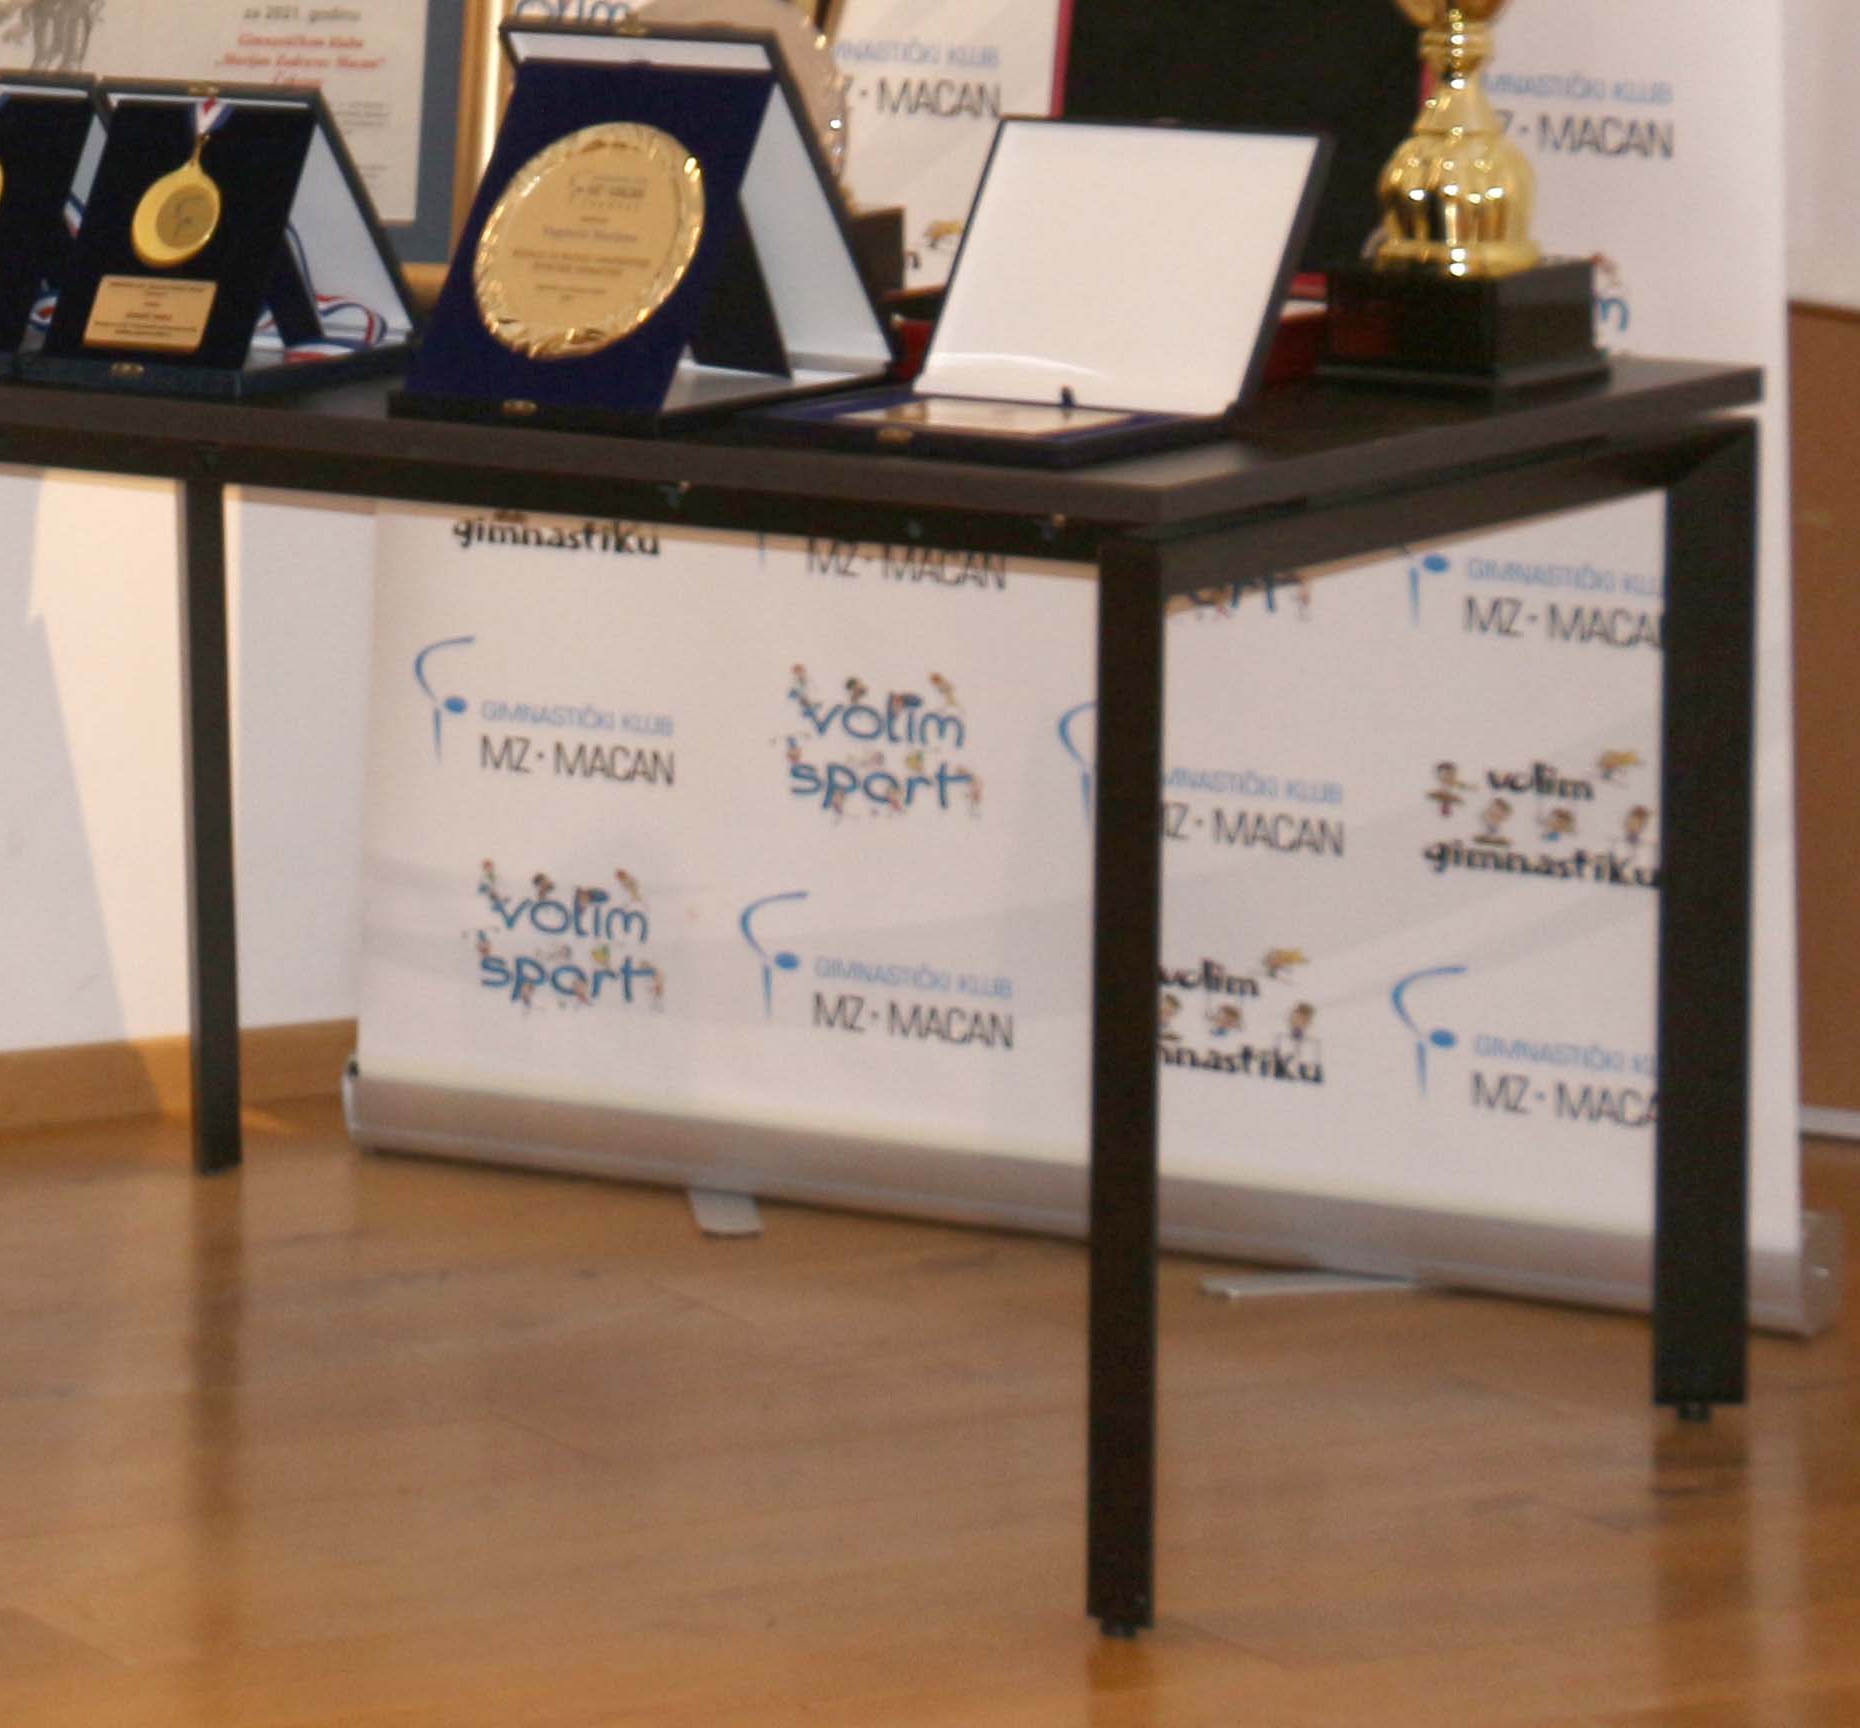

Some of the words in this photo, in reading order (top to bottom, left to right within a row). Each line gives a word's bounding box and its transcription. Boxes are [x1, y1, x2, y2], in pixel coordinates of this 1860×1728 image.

[877, 76, 1001, 119] MACAN
[1538, 113, 1675, 160] MACAN
[453, 516, 661, 556] gimnastiku
[1463, 594, 1523, 637] MZ
[1547, 602, 1662, 652] MACA
[621, 711, 674, 737] KLUB
[795, 694, 965, 748] volim
[480, 735, 531, 773] MZ
[554, 741, 675, 787] MACAN
[1487, 762, 1594, 801] volim
[789, 762, 972, 809] sport
[1213, 807, 1345, 857] MACAN
[487, 888, 649, 942] volim
[479, 955, 658, 1003] sport
[812, 992, 863, 1030] MZ
[888, 997, 1014, 1050] MACAN
[1470, 1071, 1529, 1114] MZ
